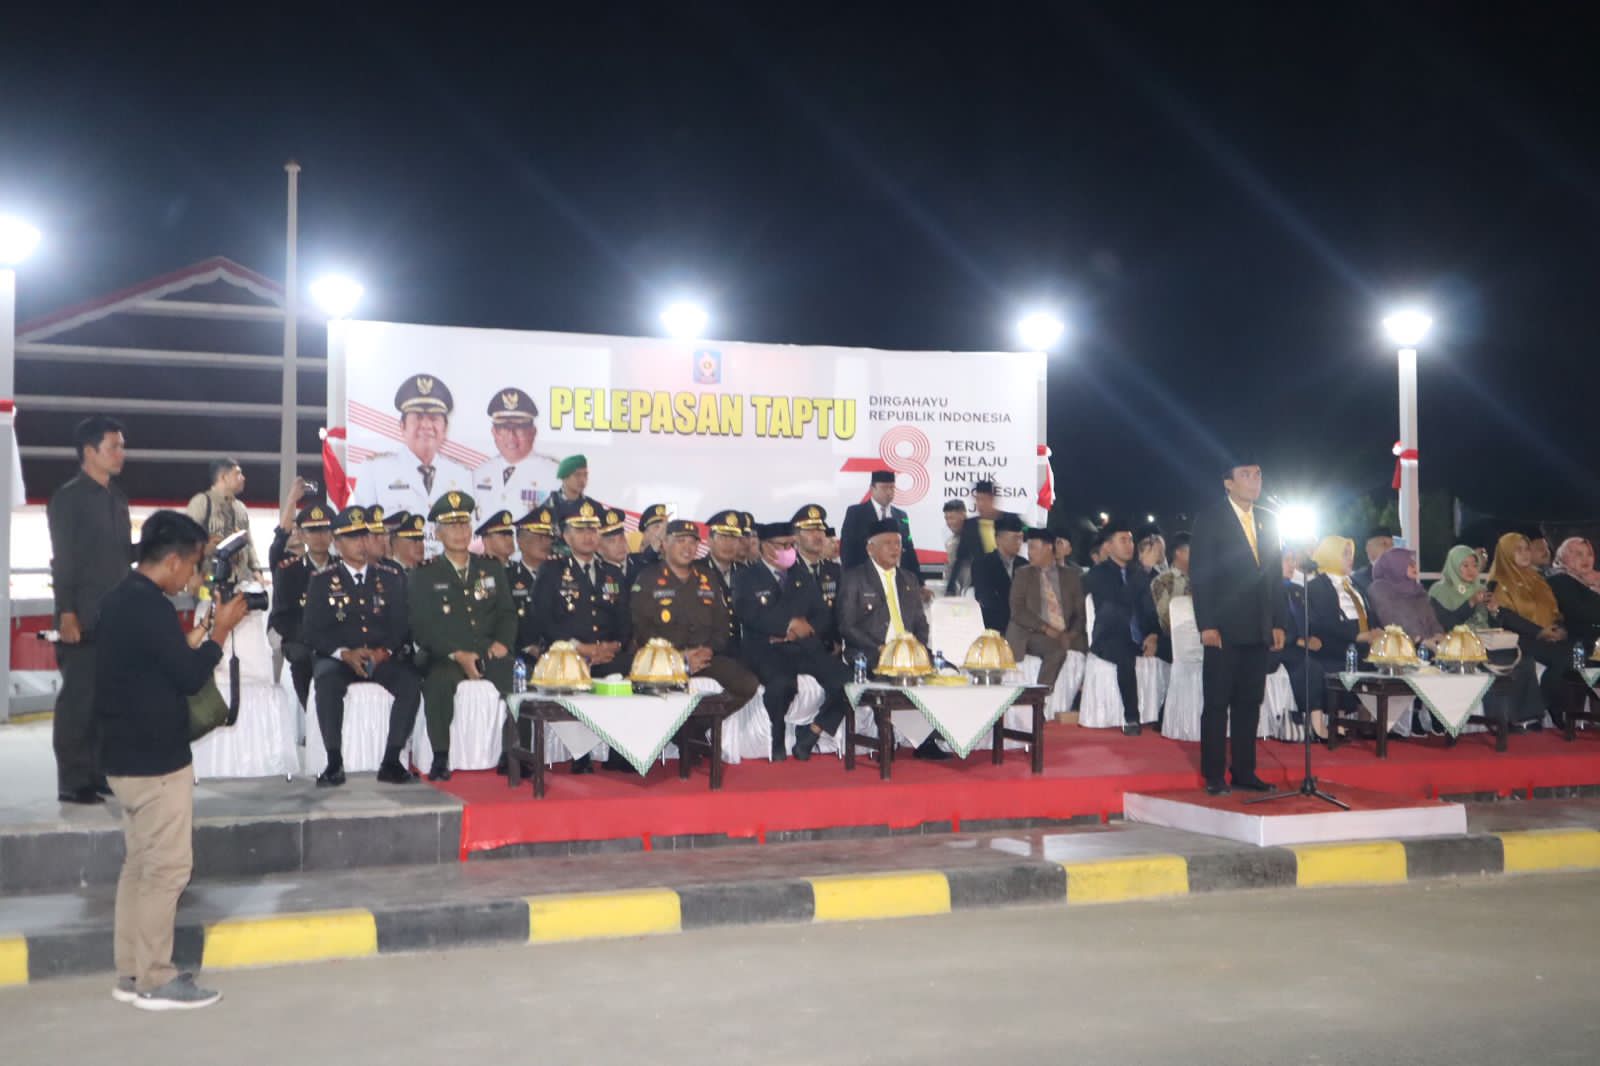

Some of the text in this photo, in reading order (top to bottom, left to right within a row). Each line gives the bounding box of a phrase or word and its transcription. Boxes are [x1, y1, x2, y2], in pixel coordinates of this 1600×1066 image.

[869, 395, 949, 408] DIRGAHAYU
[549, 386, 857, 440] PELEPASAN TAPTU
[869, 410, 1012, 423] REPUBLIK INDONESIA
[945, 440, 996, 452] TERUS
[944, 456, 1008, 468] MELAJU
[944, 471, 997, 482] UNTUK
[944, 486, 1028, 498] INDESIA
